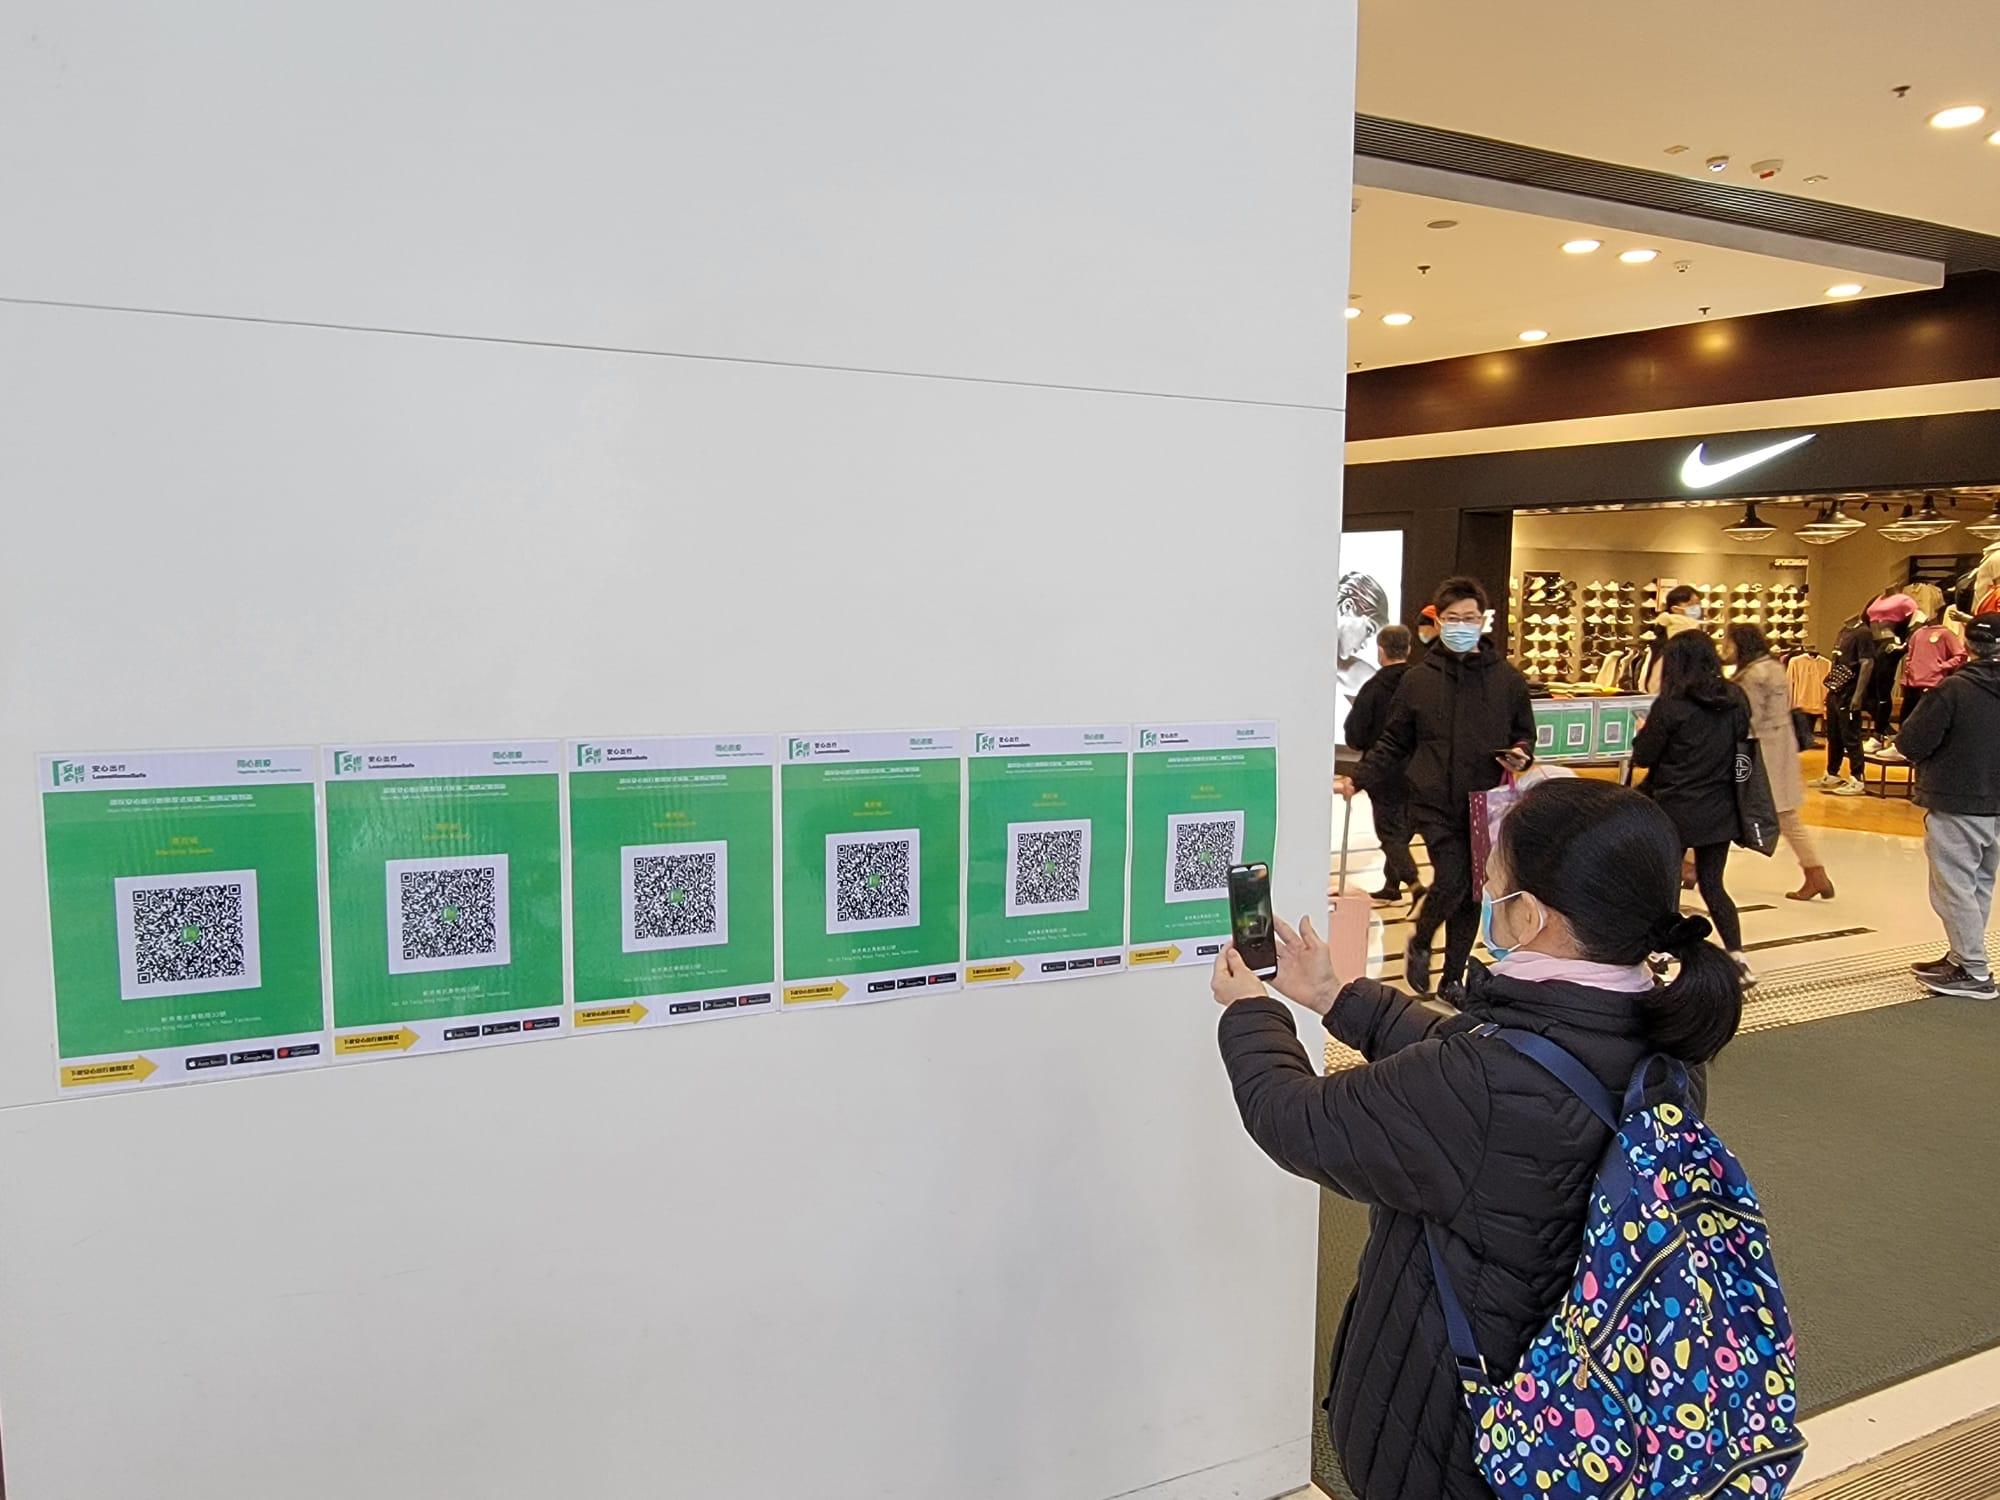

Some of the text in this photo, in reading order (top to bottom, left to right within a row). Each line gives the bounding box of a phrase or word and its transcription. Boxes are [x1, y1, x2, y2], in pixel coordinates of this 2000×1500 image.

[368, 755, 397, 763] 安心出行
[92, 764, 126, 773] 安心出行
